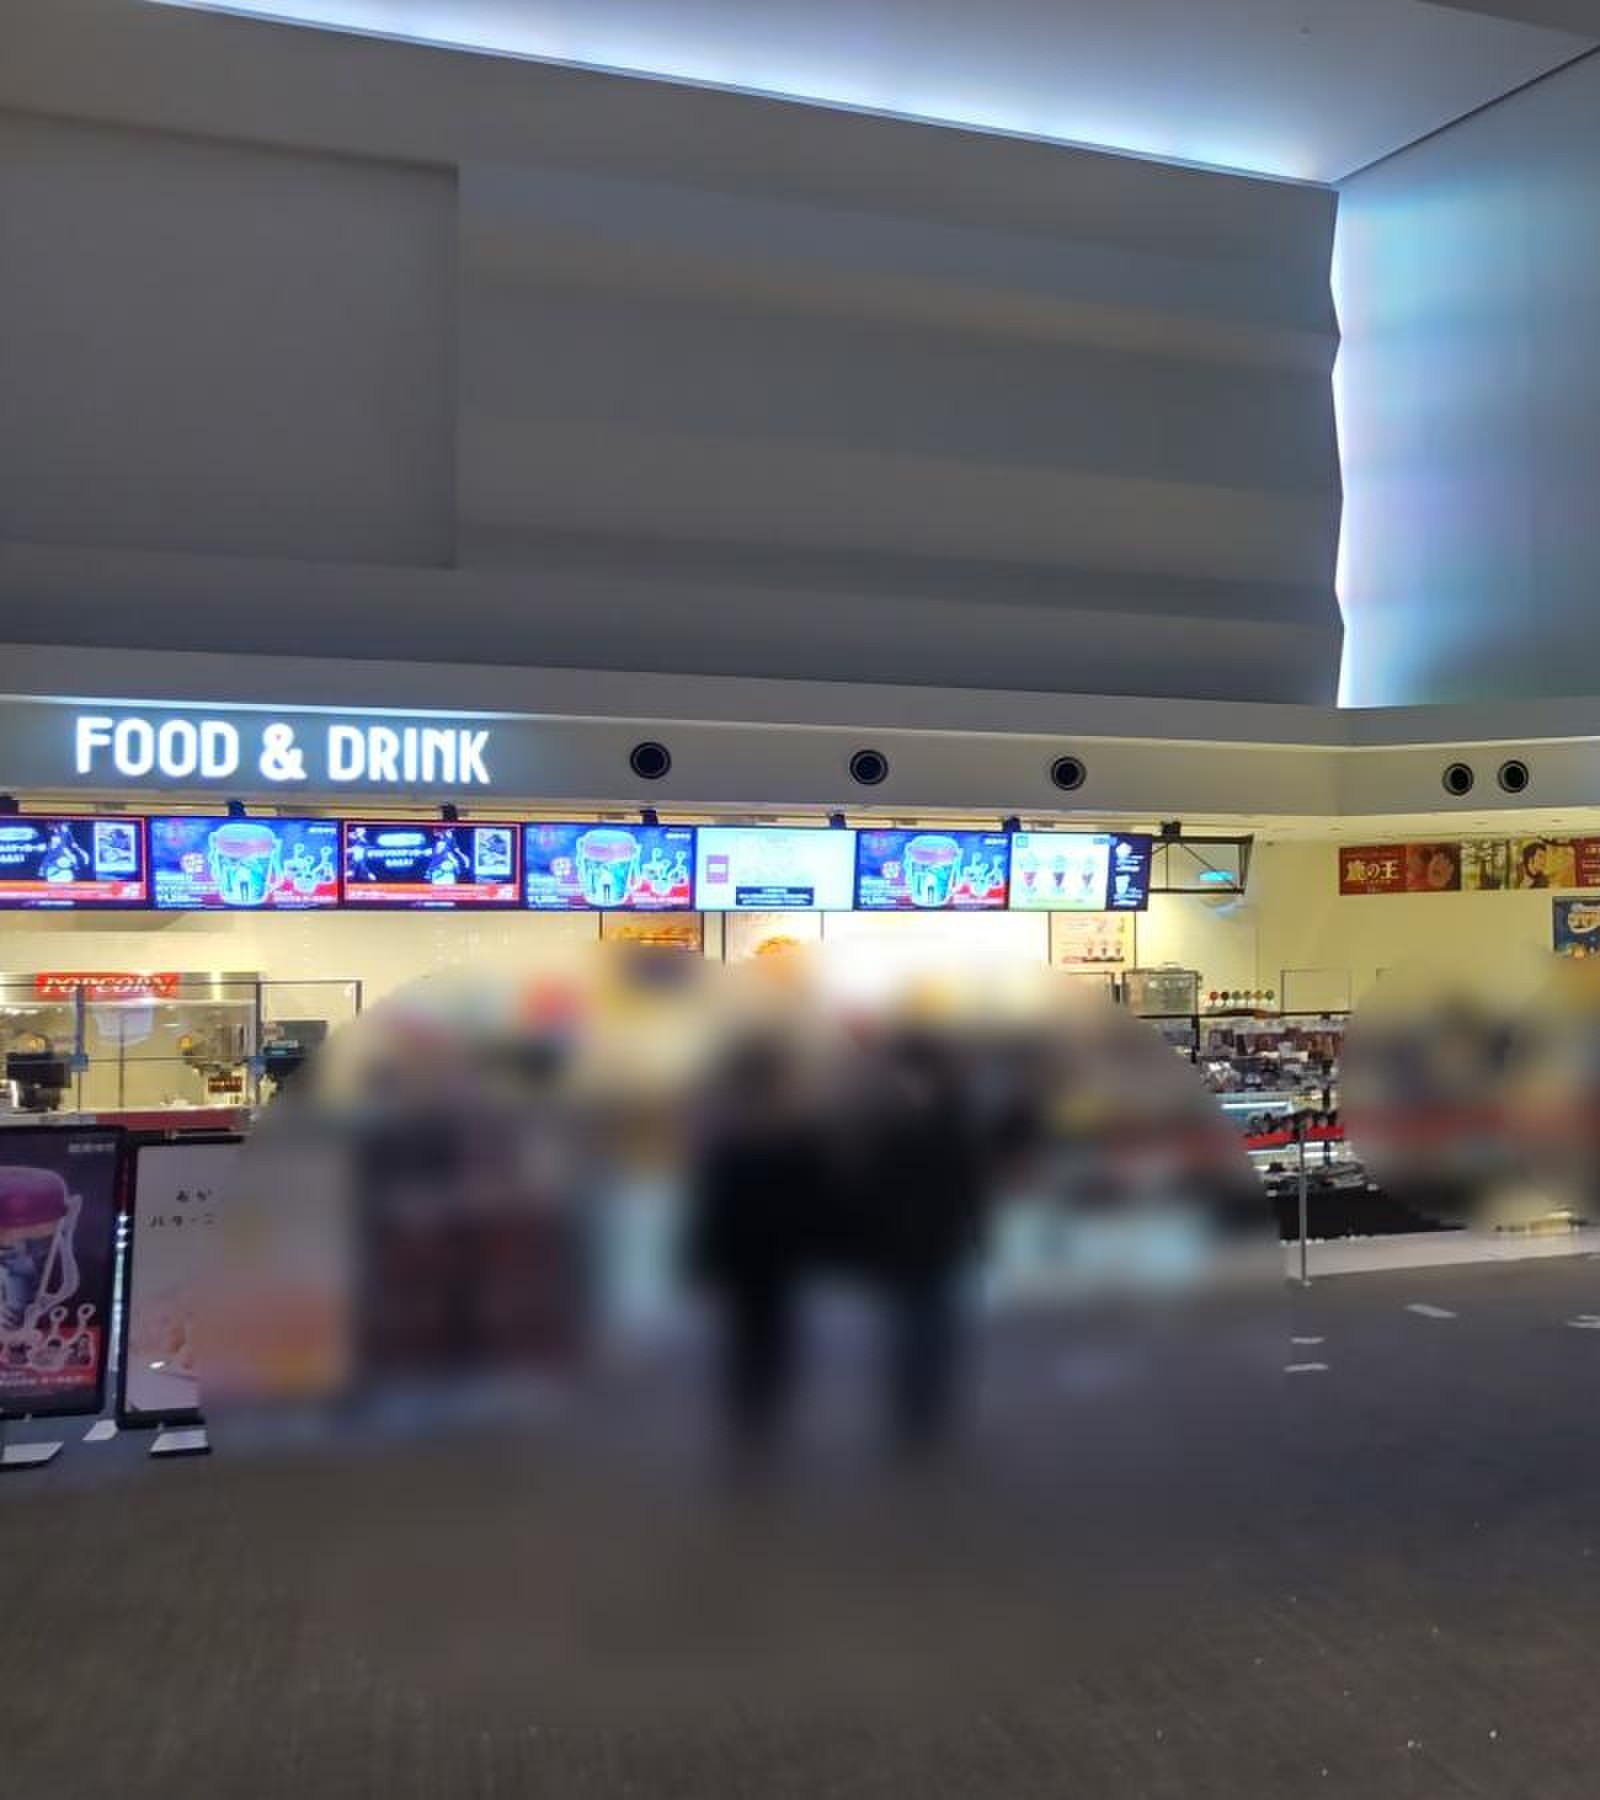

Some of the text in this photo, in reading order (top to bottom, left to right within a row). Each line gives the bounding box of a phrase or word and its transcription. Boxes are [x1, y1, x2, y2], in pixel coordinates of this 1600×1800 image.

[76, 716, 490, 784] FOOD & DRINK
